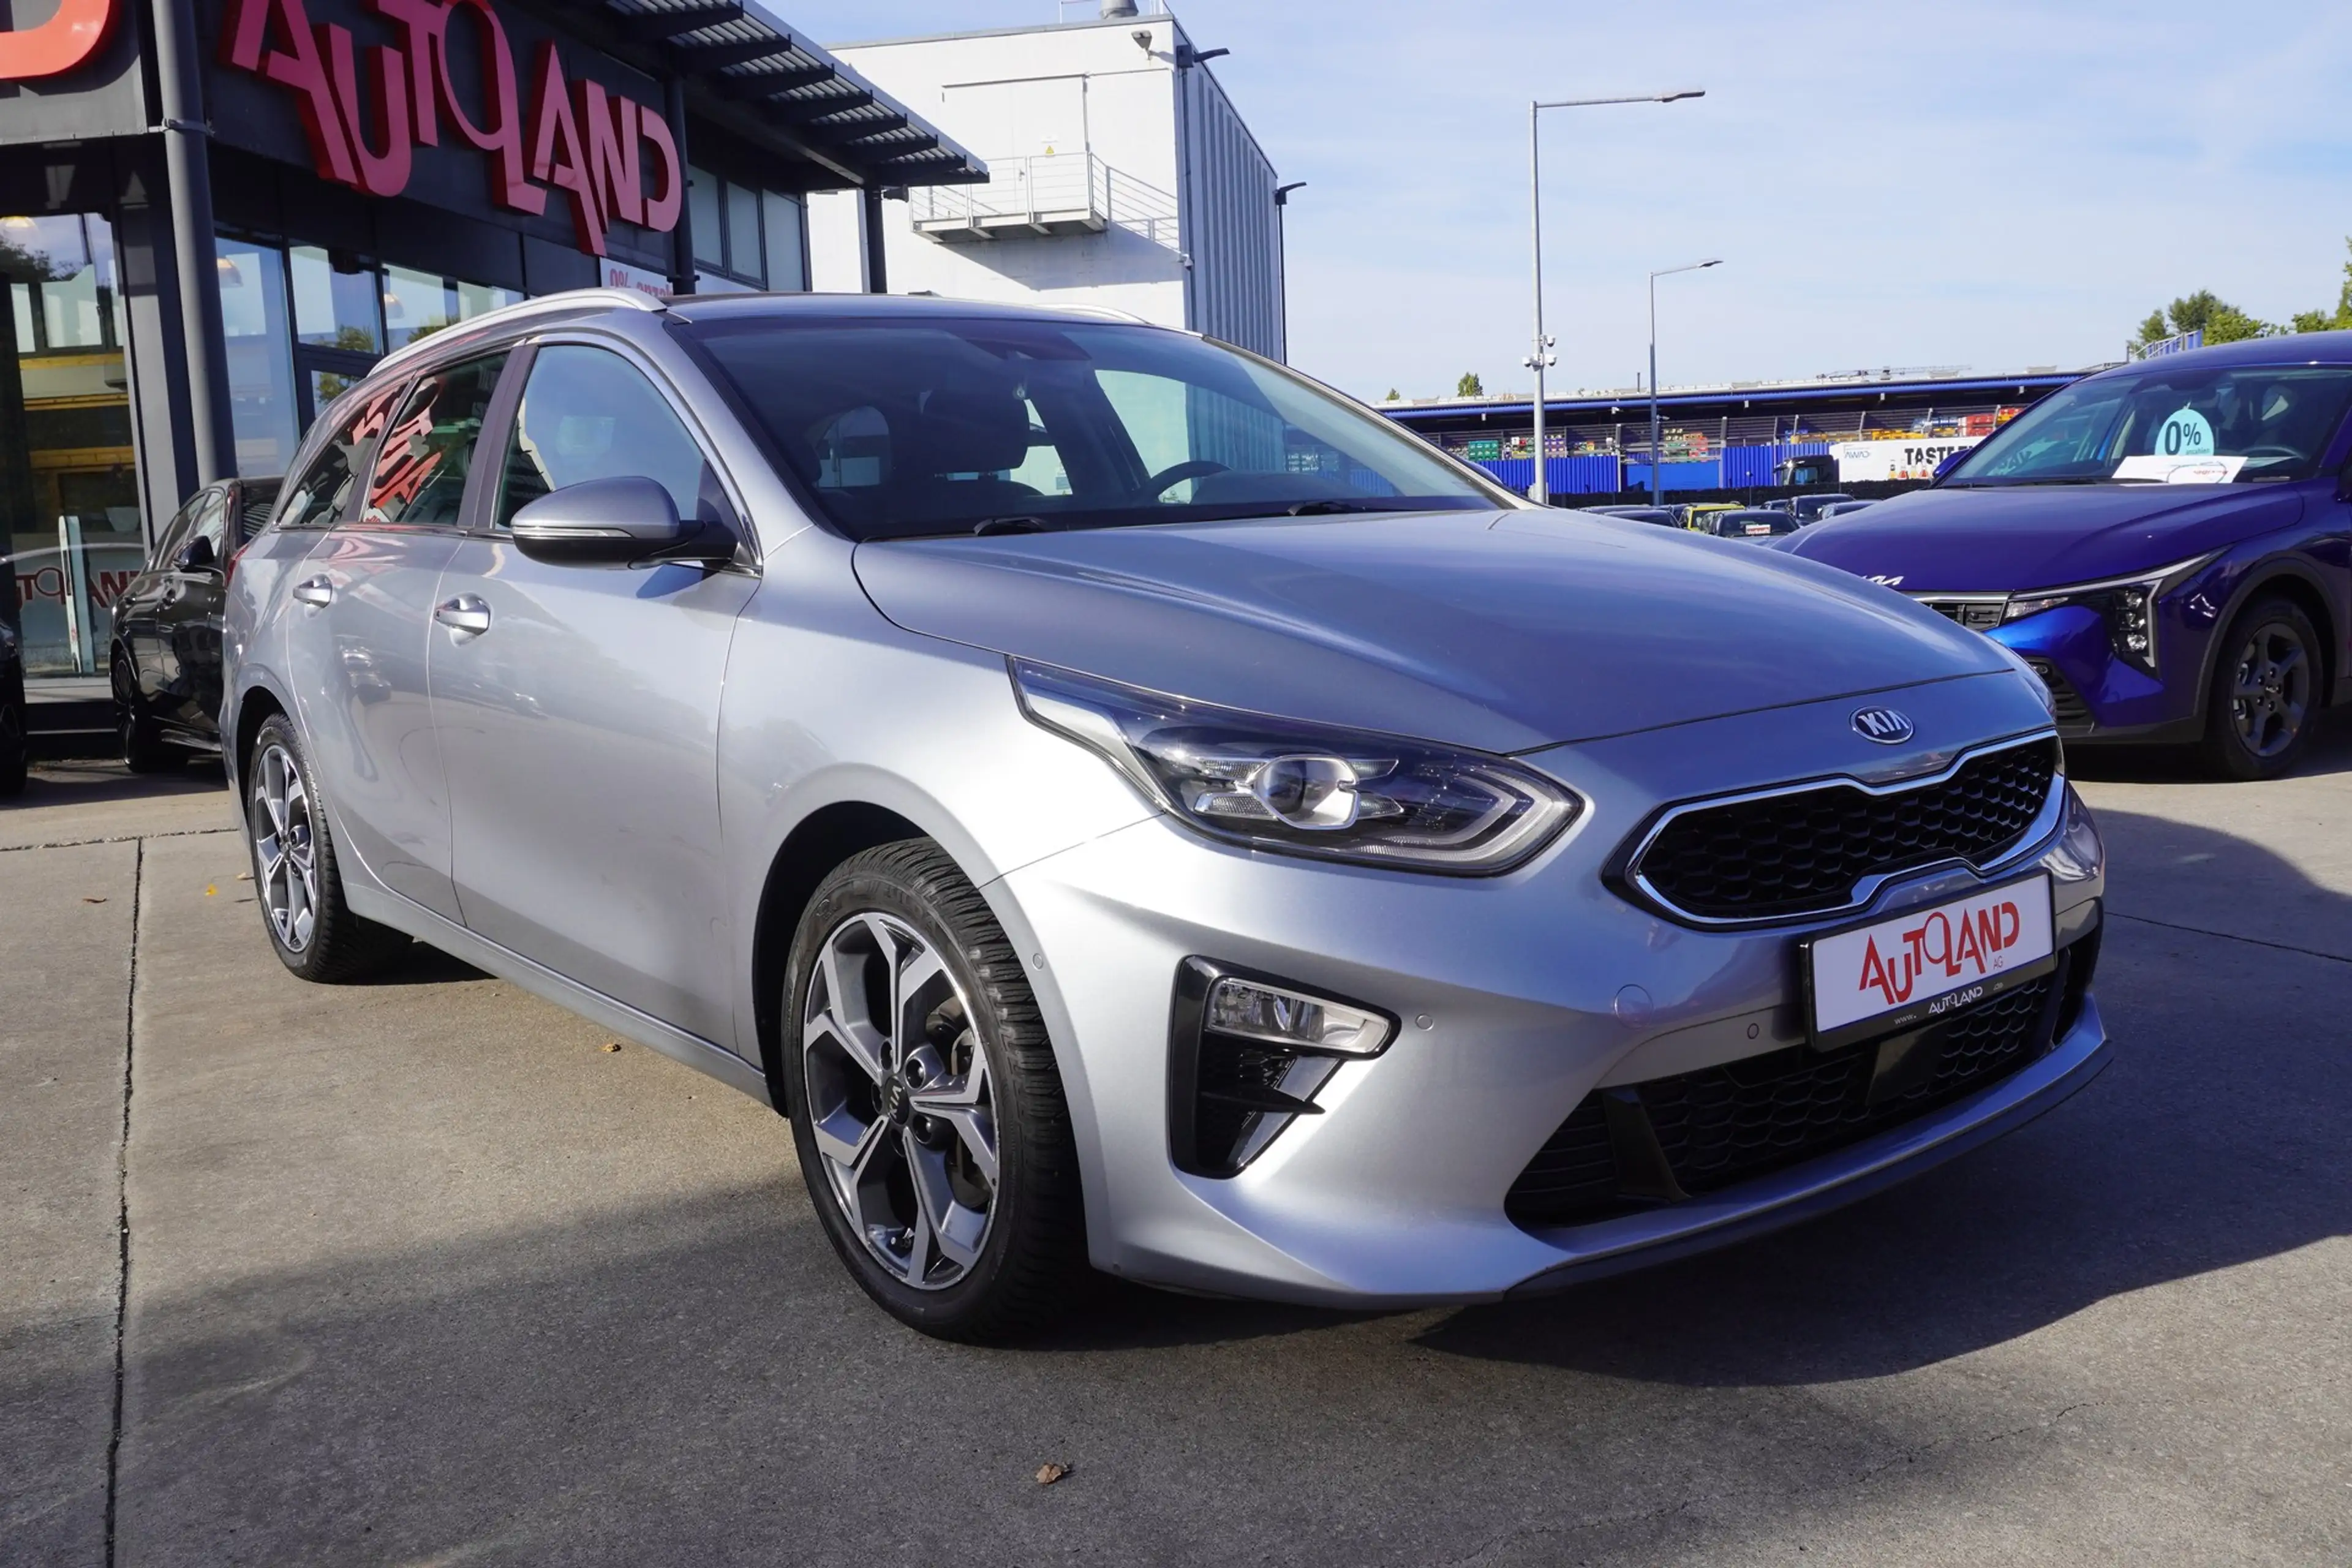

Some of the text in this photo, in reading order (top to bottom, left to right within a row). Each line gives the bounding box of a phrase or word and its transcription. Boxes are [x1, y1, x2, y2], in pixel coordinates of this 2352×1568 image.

[222, 0, 682, 257] AUTOLAND
[2164, 421, 2201, 456] 0%
[1858, 709, 1910, 736] KIA
[1858, 901, 2020, 1005] AUTOLAND
[1992, 955, 2003, 971] AG
[1928, 986, 1983, 1014] AUTOLAND
